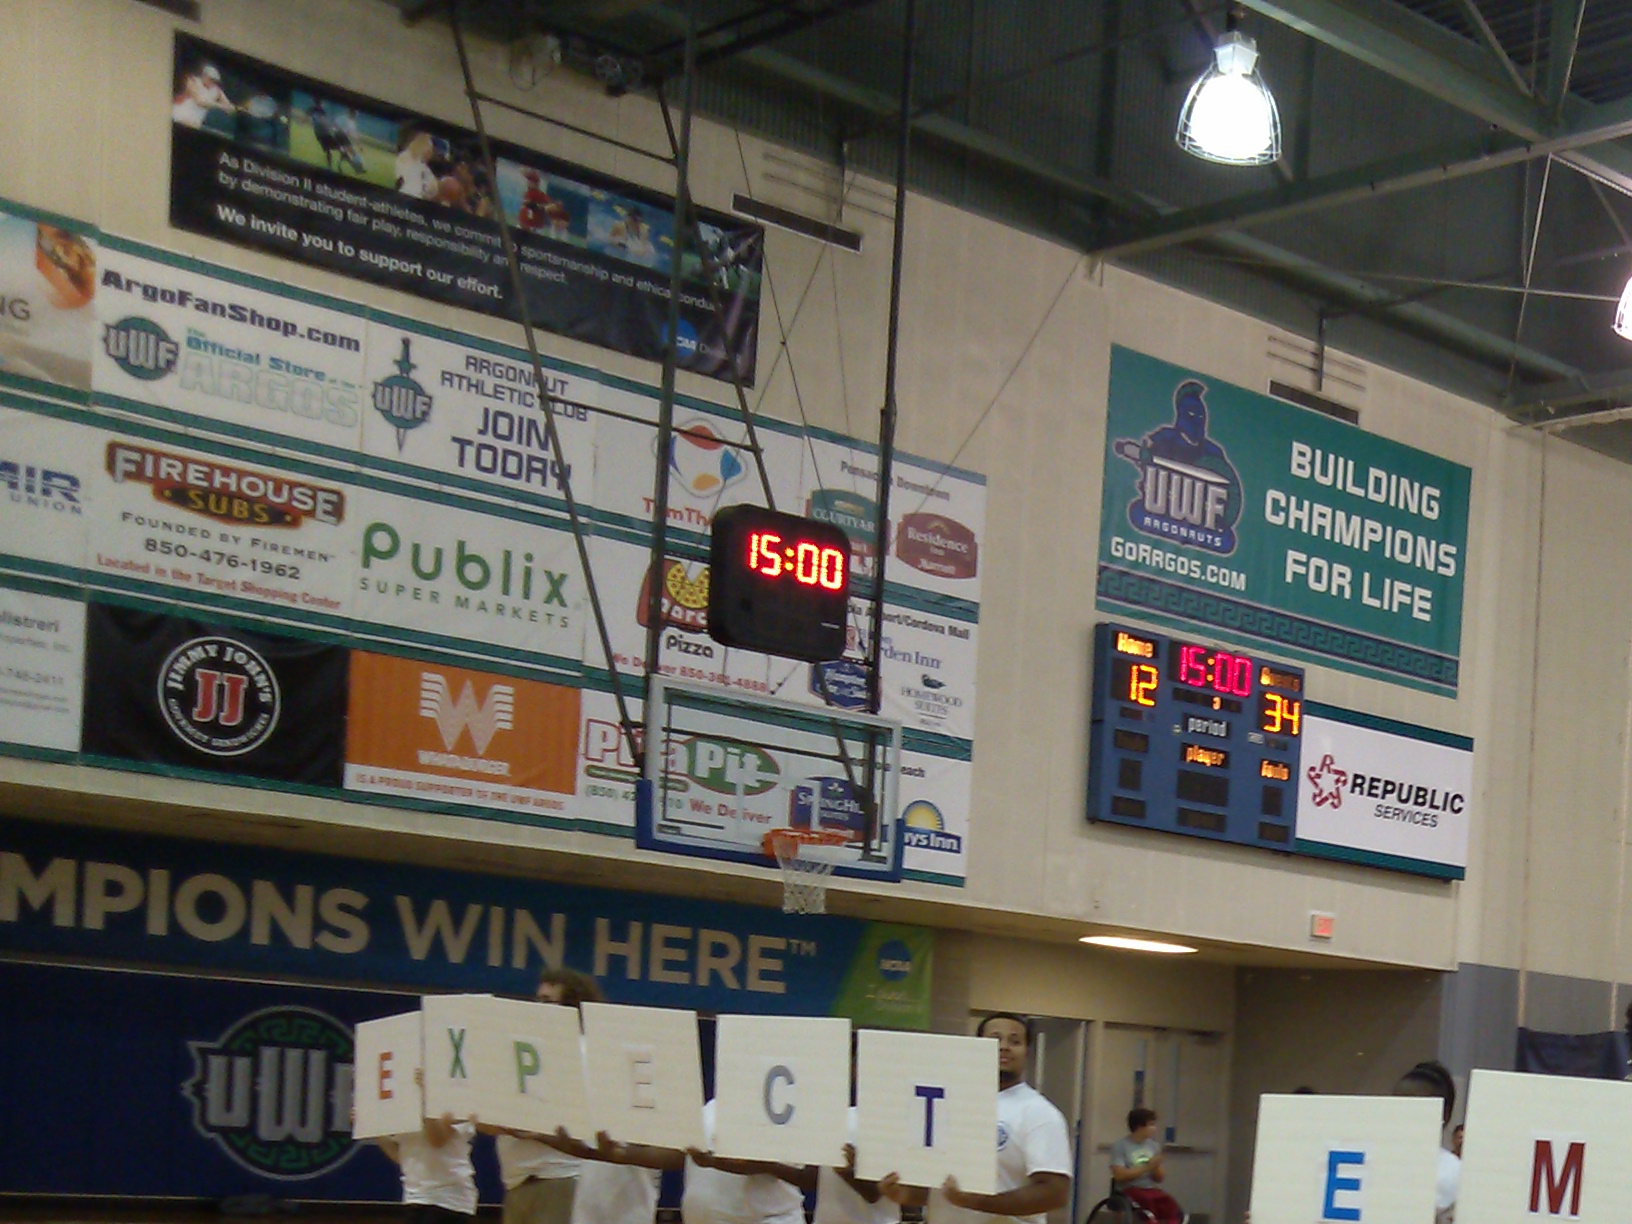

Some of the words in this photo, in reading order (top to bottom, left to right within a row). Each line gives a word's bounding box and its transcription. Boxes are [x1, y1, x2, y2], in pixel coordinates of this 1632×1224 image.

[218, 151, 239, 170] As
[243, 159, 300, 189] Division
[611, 270, 634, 288] and
[216, 203, 246, 227] We
[250, 212, 299, 242] invite
[300, 230, 334, 254] you
[337, 238, 356, 257] to
[359, 246, 424, 279] support
[425, 266, 454, 286] our
[456, 274, 504, 300] effort.
[101, 268, 361, 352] ArgoFanShop.com
[104, 326, 179, 371] UWF
[186, 335, 261, 366] Official
[268, 356, 327, 382] Store
[374, 382, 432, 420] UWF
[441, 369, 535, 407] ATHLETIC
[477, 406, 551, 450] JOIN
[114, 448, 343, 526] FIREHOUSE
[451, 436, 572, 490] TODAY
[1290, 440, 1441, 521] BUILDING
[188, 490, 271, 523] SUBS
[1144, 464, 1231, 531] UWF
[121, 512, 212, 539] FOUNDED
[219, 532, 241, 545] BY
[907, 526, 968, 554] Residence
[1143, 515, 1223, 548] ARGONAUTS
[1264, 489, 1458, 577] CHAMPIONS
[97, 553, 151, 574] Located
[154, 564, 167, 577] in
[170, 568, 192, 583] the
[196, 571, 237, 592] Target
[240, 580, 299, 602] Shopping
[144, 538, 301, 580] 850-476-1962
[361, 521, 569, 608] Publix
[750, 532, 843, 590] 15:00
[1110, 536, 1247, 592] GOARGOS.COM
[359, 577, 440, 603] SUPER
[454, 595, 569, 628] MARKETS
[1284, 549, 1352, 600] FOR
[1361, 571, 1433, 622] LIFE
[665, 634, 715, 659] Pizza
[915, 650, 942, 670] Inn
[1180, 645, 1254, 697] 15:00
[166, 643, 219, 691] JIMMY
[222, 646, 273, 703] JOHN'S
[191, 668, 249, 727] JJ
[1129, 664, 1159, 707] 12
[1187, 716, 1228, 738] period
[1262, 691, 1301, 735] 34
[1185, 744, 1226, 767] player
[688, 798, 711, 815] We
[717, 803, 772, 824] Deiver
[1350, 773, 1465, 816] REPUBLIC
[1373, 803, 1439, 829] SERVICES
[930, 833, 959, 851] Inn
[396, 893, 567, 973] WIN
[378, 1051, 393, 1100] E
[447, 1027, 468, 1079] X
[513, 1040, 540, 1093] P
[631, 1055, 657, 1109] E
[762, 1064, 795, 1126] C
[914, 1085, 945, 1147] T
[1322, 1150, 1366, 1223] E
[1528, 1139, 1586, 1217] M
